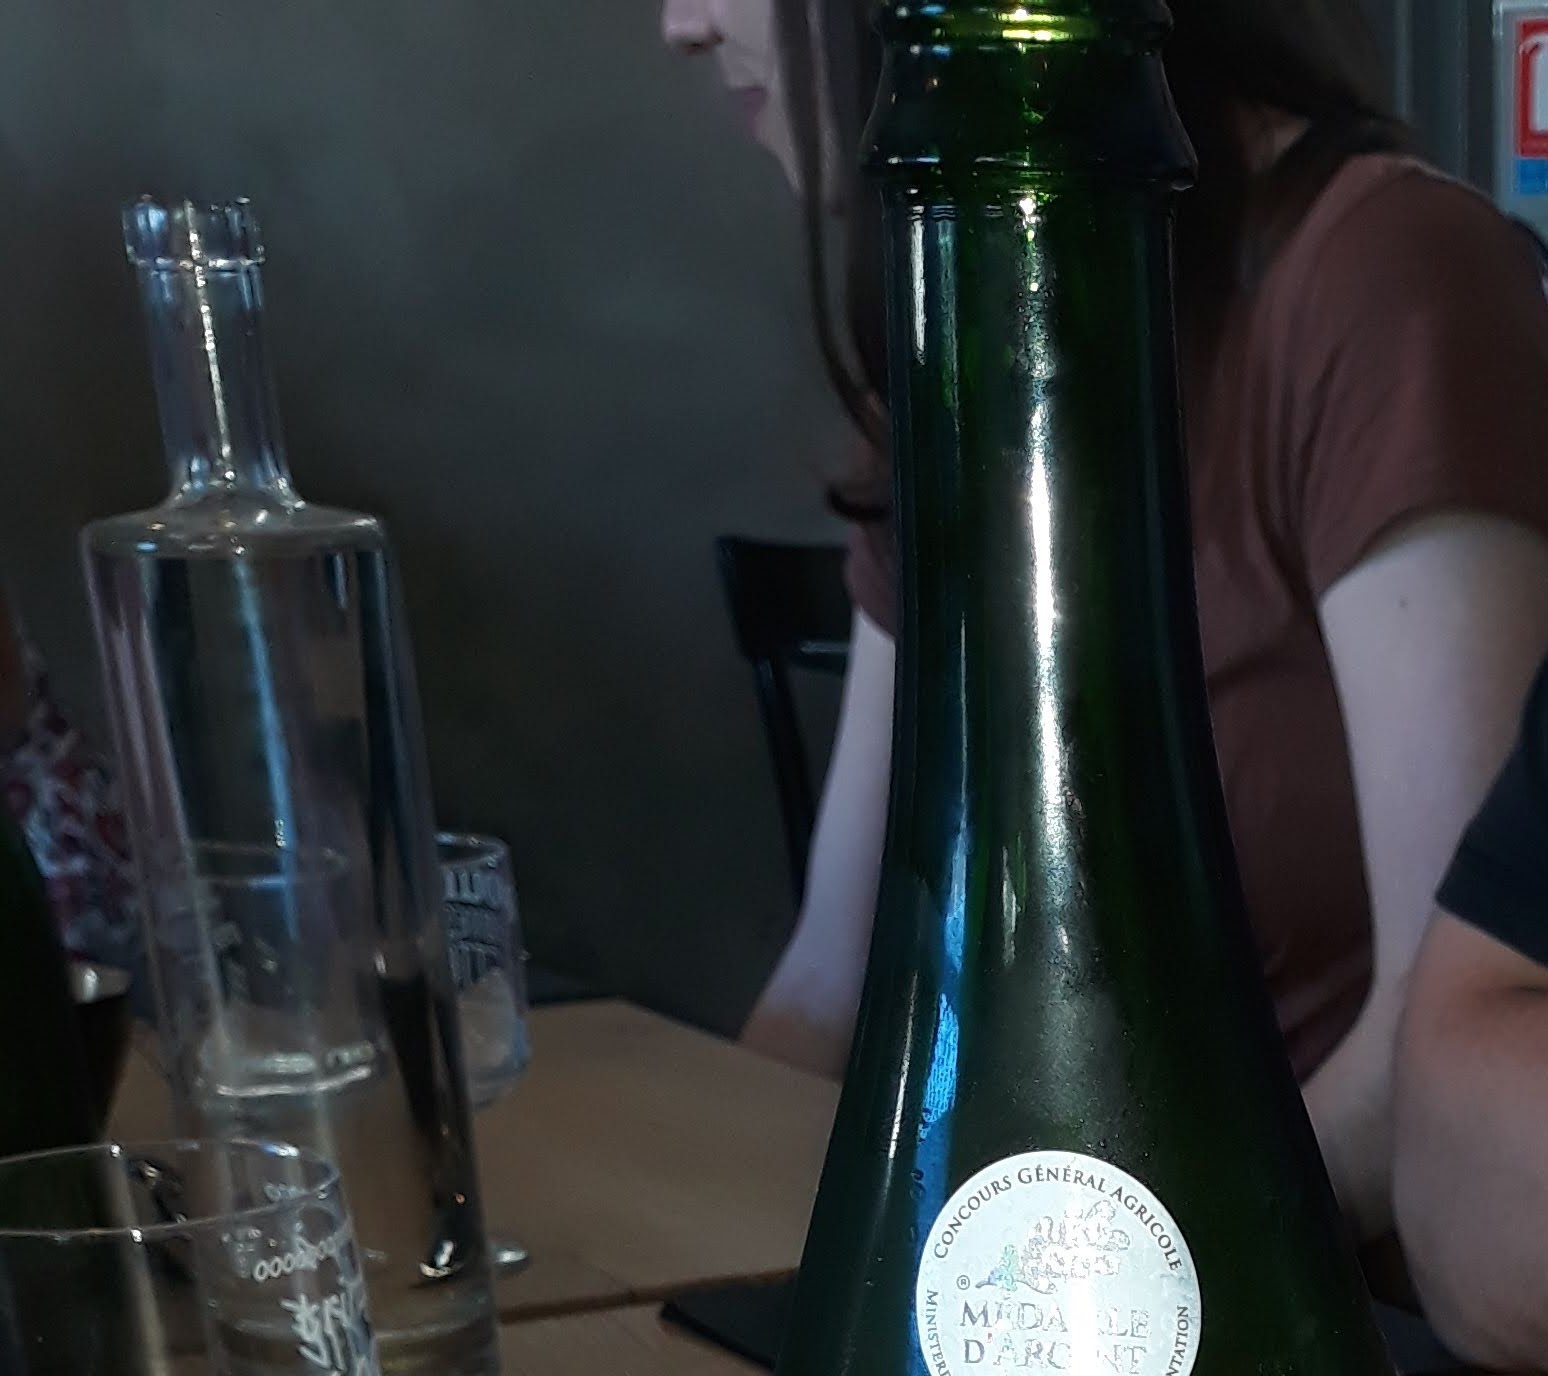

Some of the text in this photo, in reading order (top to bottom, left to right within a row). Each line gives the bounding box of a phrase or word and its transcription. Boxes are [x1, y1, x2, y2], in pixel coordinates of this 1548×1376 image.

[933, 1164, 1183, 1272] CONCOURS GÉNÉRAL AGRICOLE
